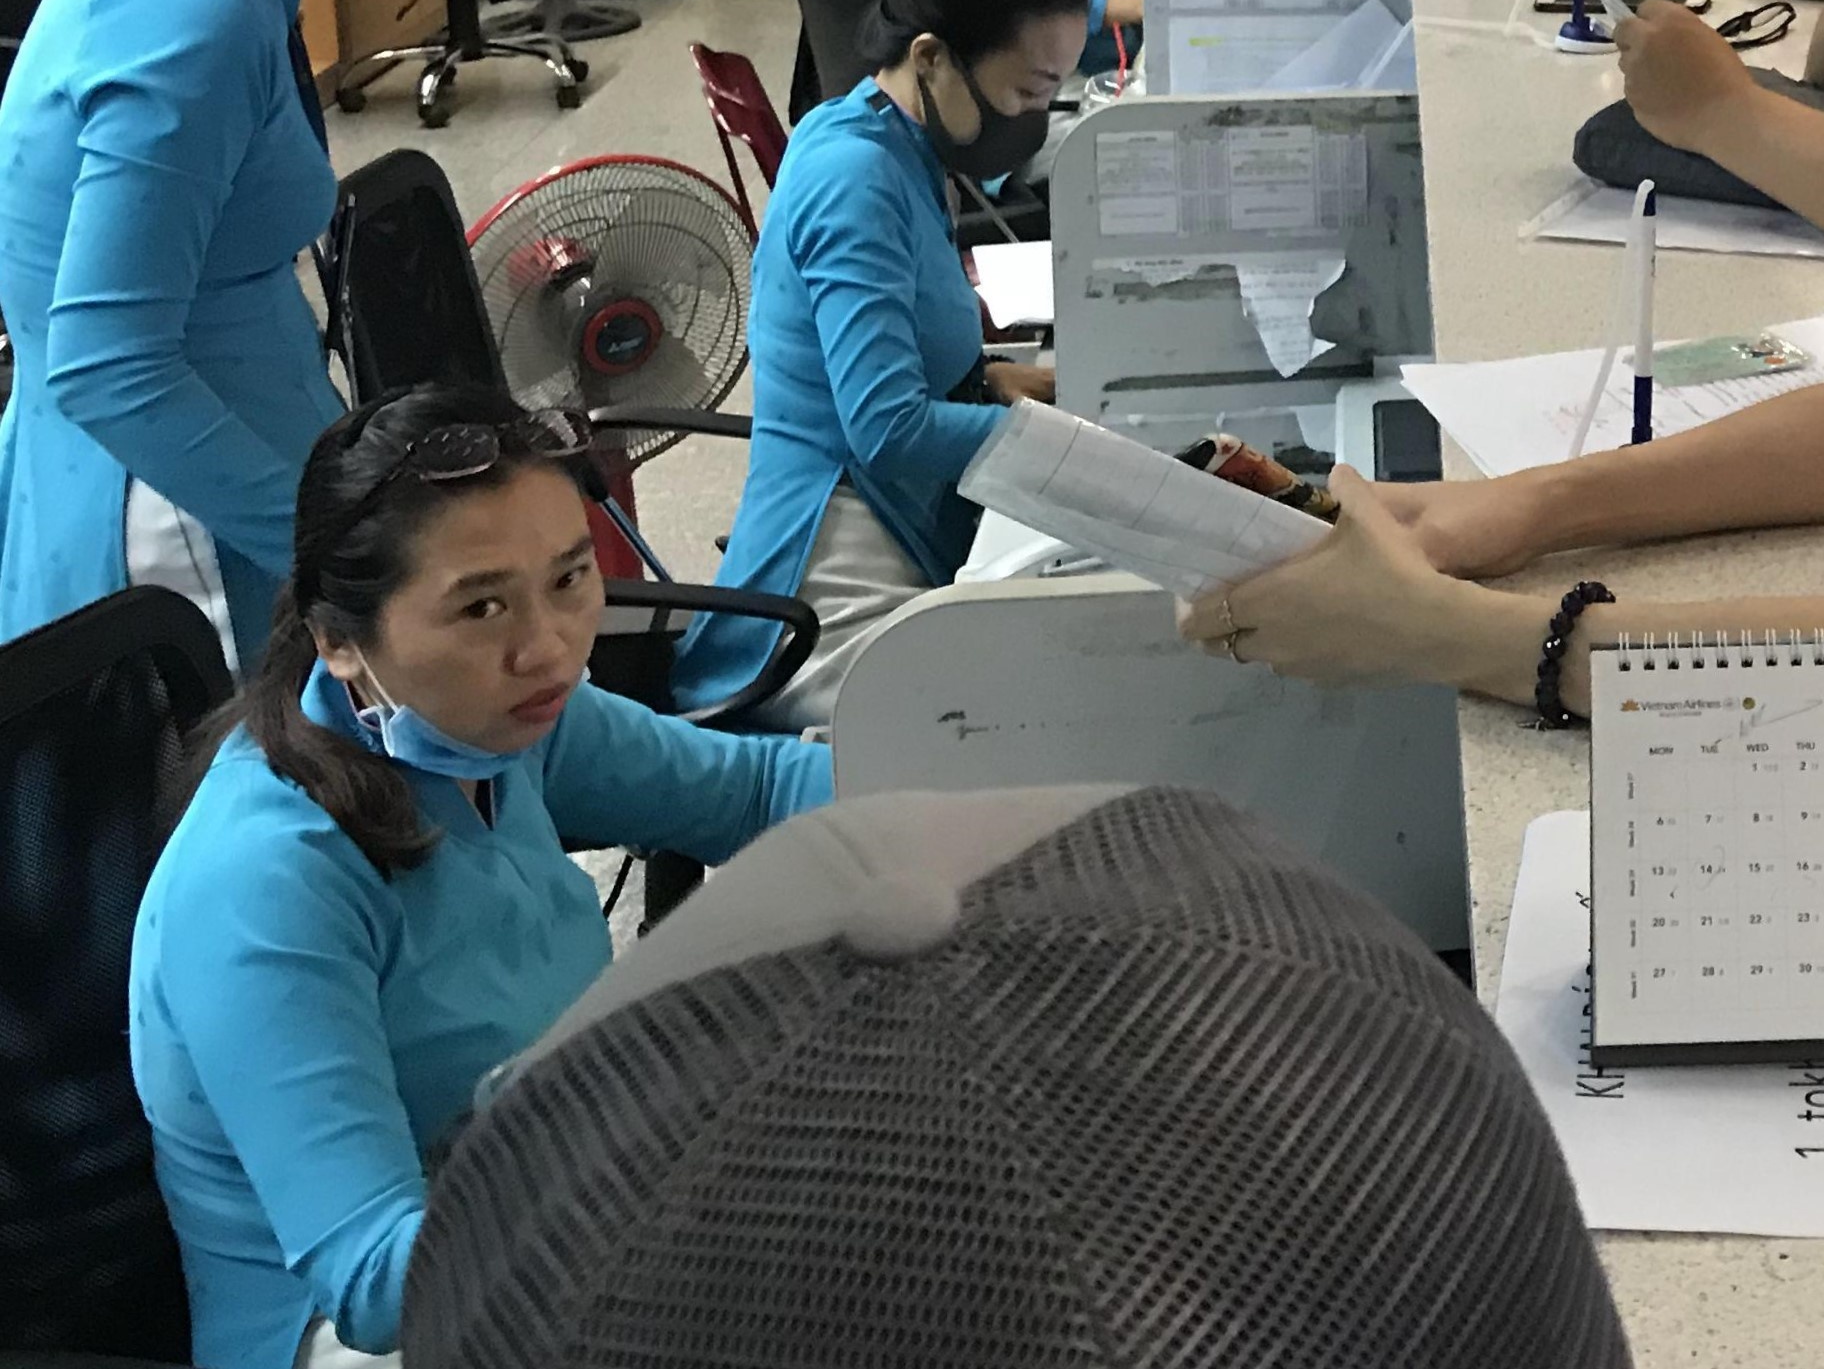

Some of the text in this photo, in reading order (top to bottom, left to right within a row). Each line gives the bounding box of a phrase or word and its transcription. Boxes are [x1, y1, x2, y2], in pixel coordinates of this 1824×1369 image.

[1701, 744, 1719, 754] TUE
[1746, 742, 1769, 752] WED
[1796, 741, 1816, 750] THU
